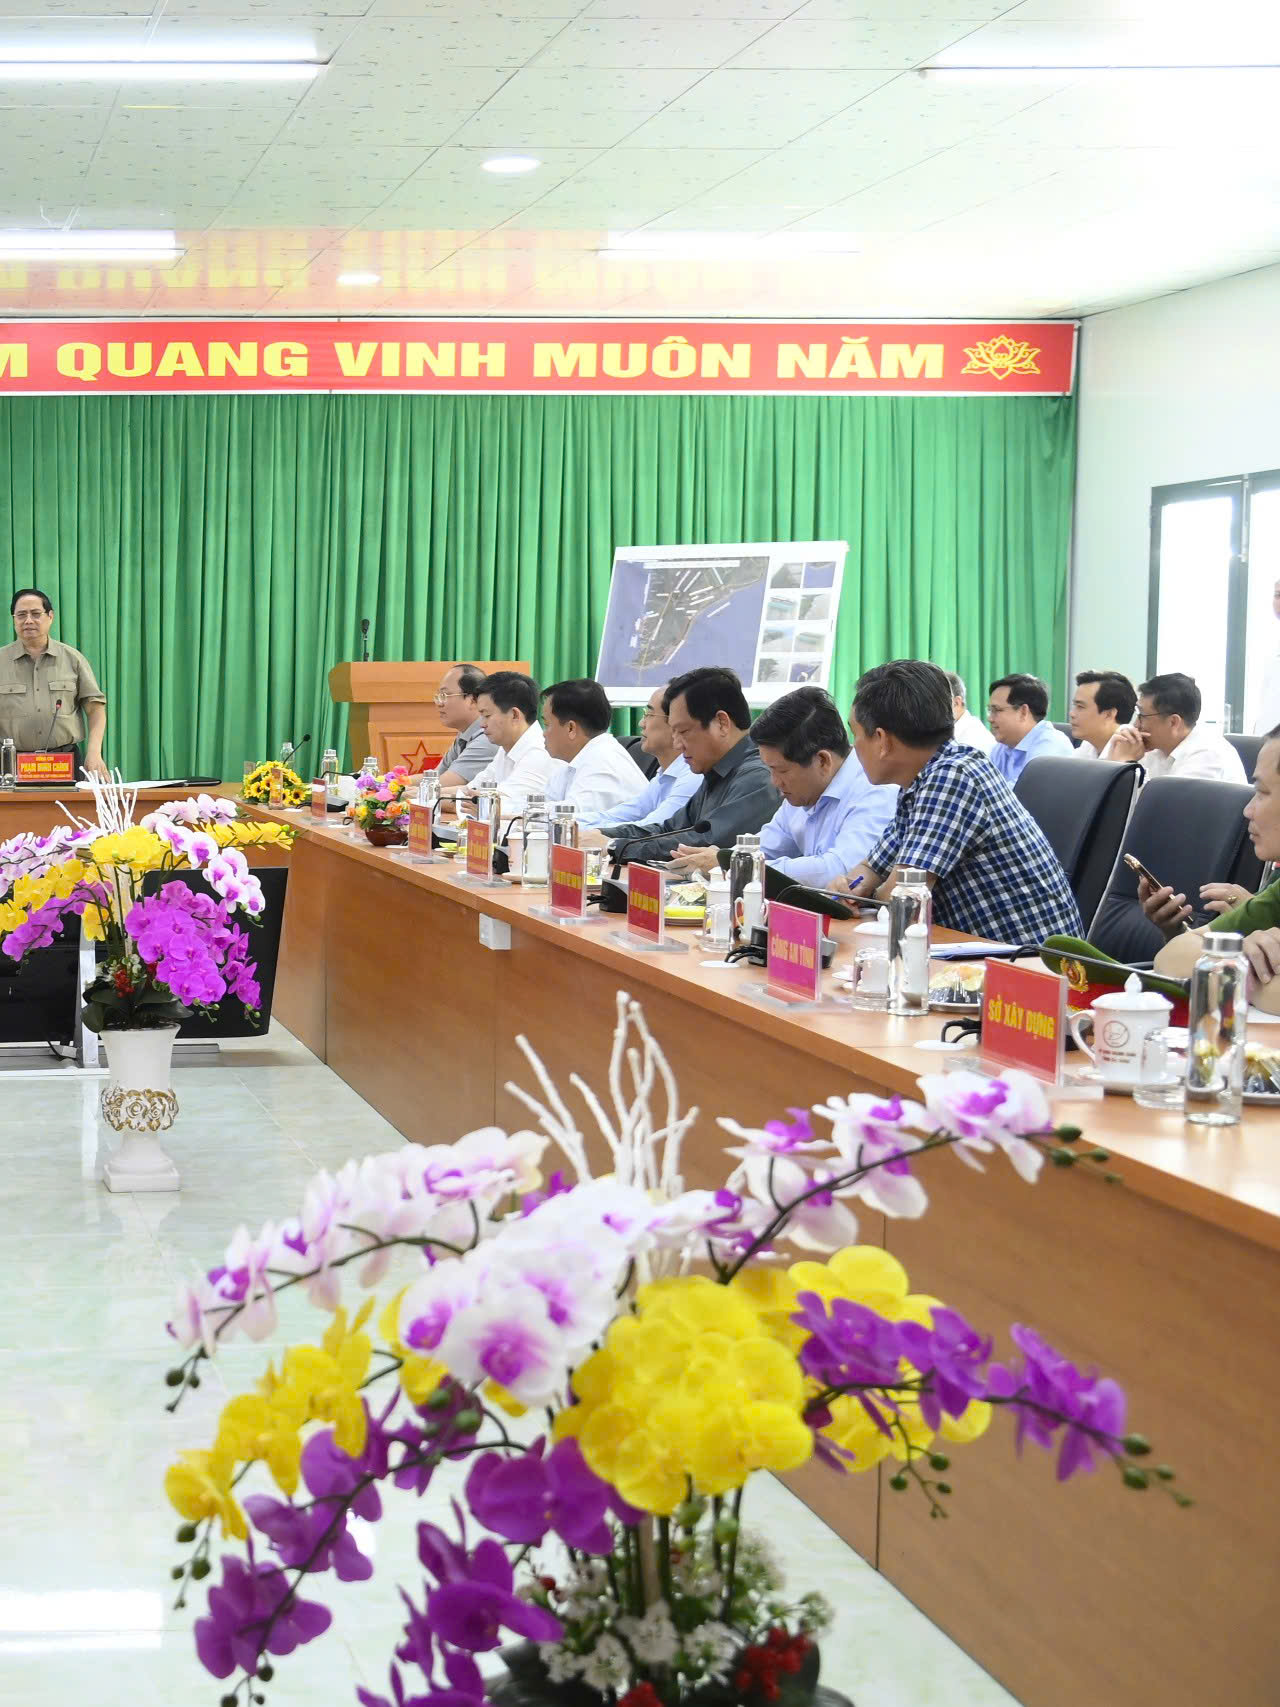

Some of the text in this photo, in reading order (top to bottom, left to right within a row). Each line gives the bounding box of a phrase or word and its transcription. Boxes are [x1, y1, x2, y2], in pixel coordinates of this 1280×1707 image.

[56, 342, 308, 382] QUANG
[333, 342, 506, 377] VINH
[532, 336, 751, 378] MUÔN
[776, 336, 945, 379] NĂM
[988, 992, 1055, 1040] SỞ XÂY DỰNG
